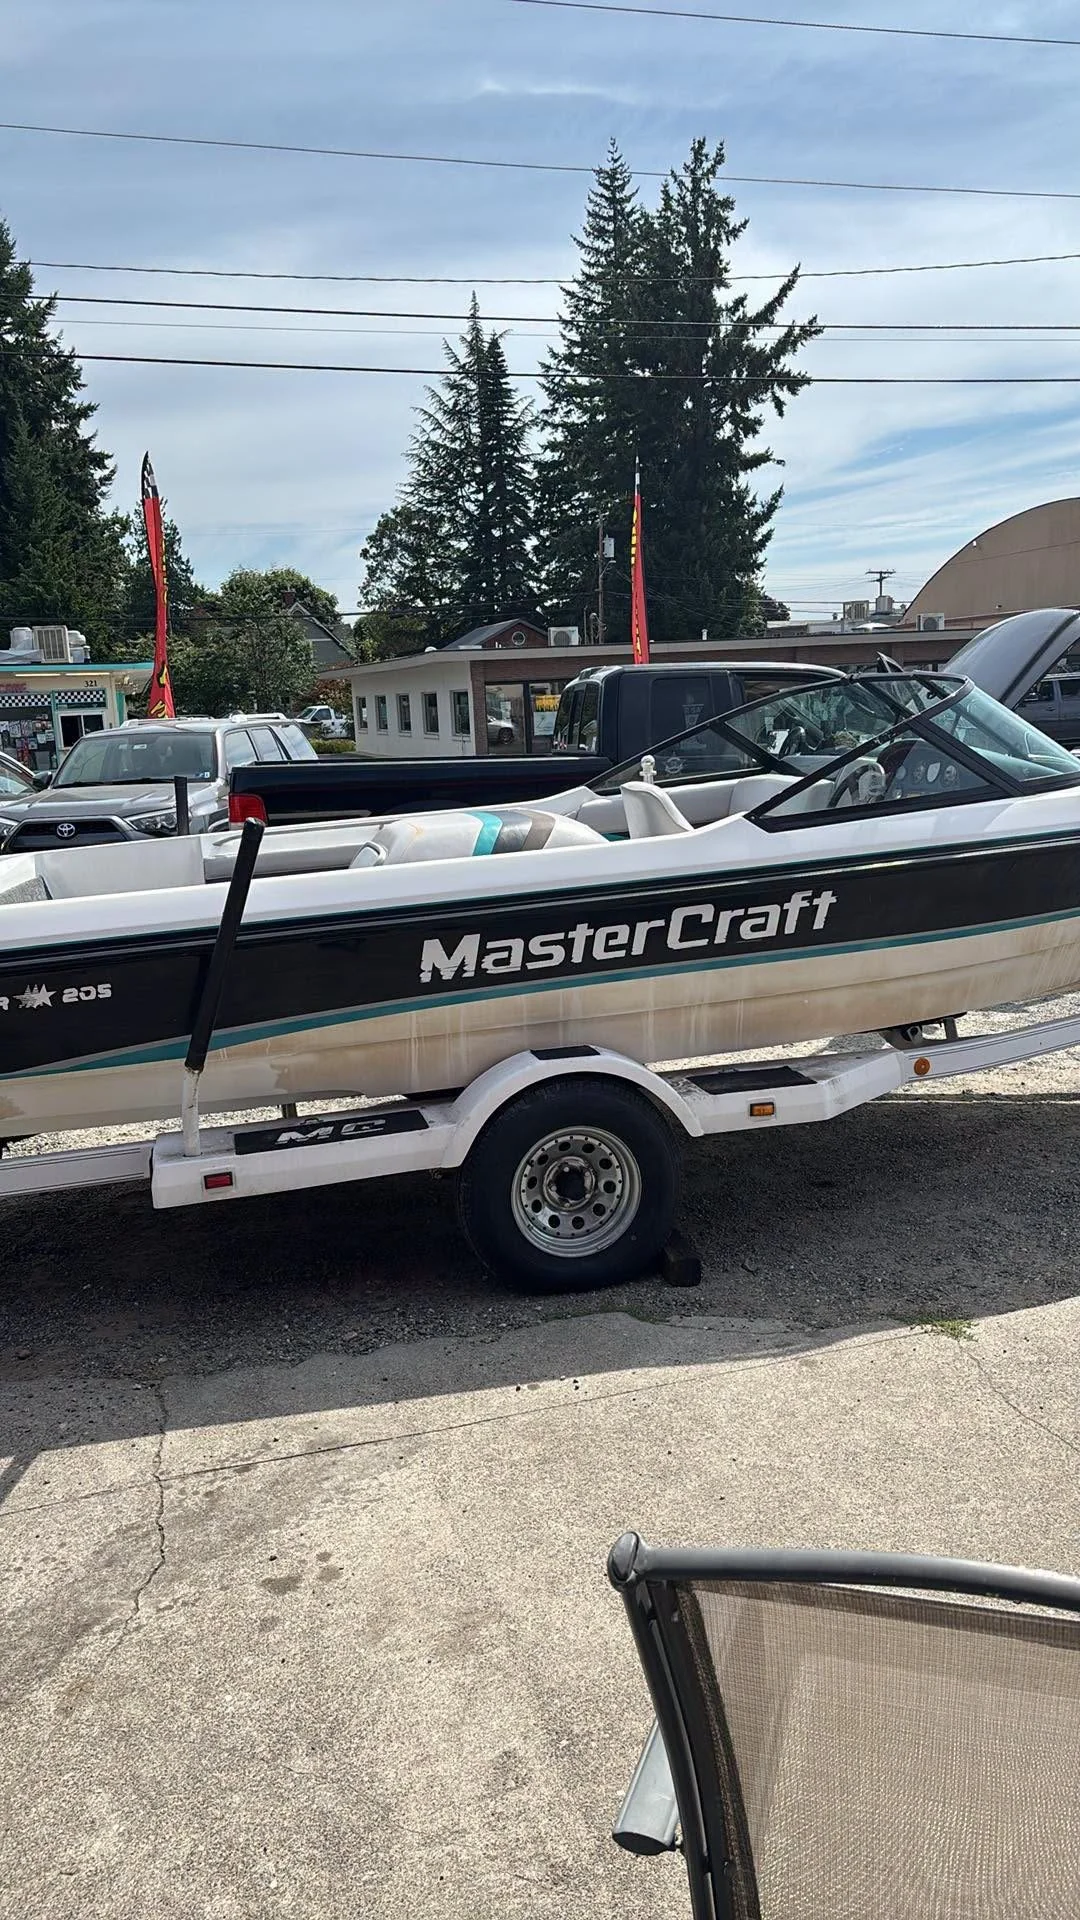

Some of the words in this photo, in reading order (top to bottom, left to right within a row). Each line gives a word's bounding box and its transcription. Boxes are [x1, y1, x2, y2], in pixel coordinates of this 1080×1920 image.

[84, 680, 97, 688] 321
[419, 889, 837, 983] MasterCraft
[62, 983, 112, 1003] 205
